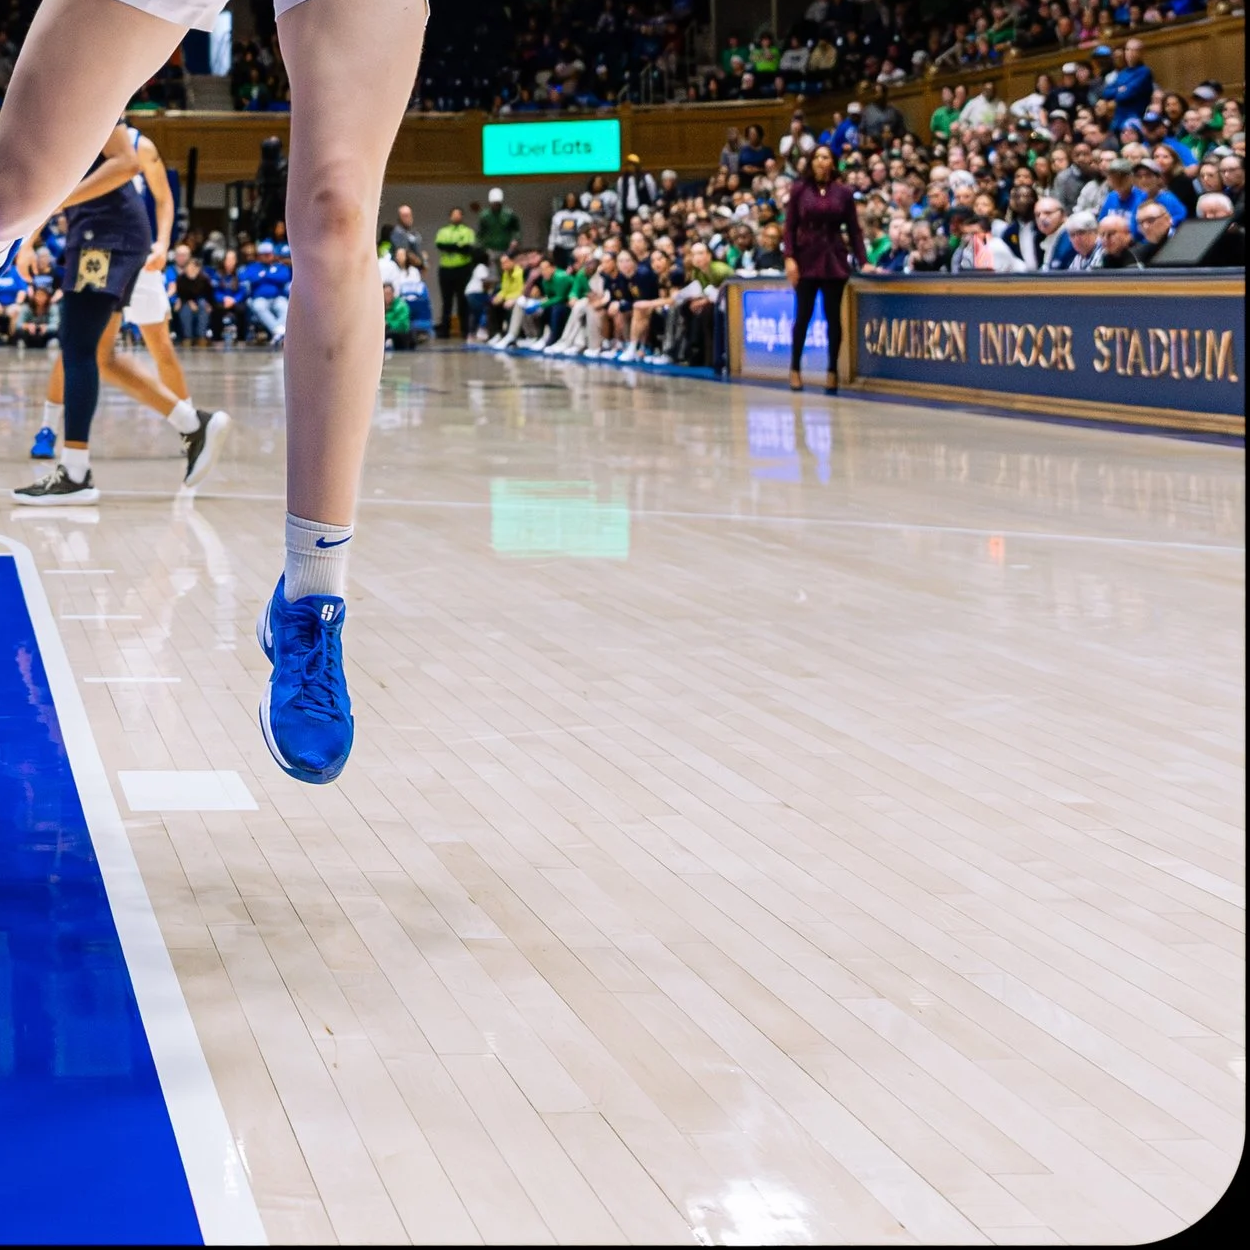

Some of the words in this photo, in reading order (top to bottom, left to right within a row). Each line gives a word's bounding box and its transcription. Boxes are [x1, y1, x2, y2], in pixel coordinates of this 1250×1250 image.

[508, 141, 547, 157] Uber
[552, 139, 593, 156] Eats
[865, 317, 967, 363] CAMERON
[979, 322, 1076, 371] INDOOR
[1093, 325, 1239, 383] STADIUM
